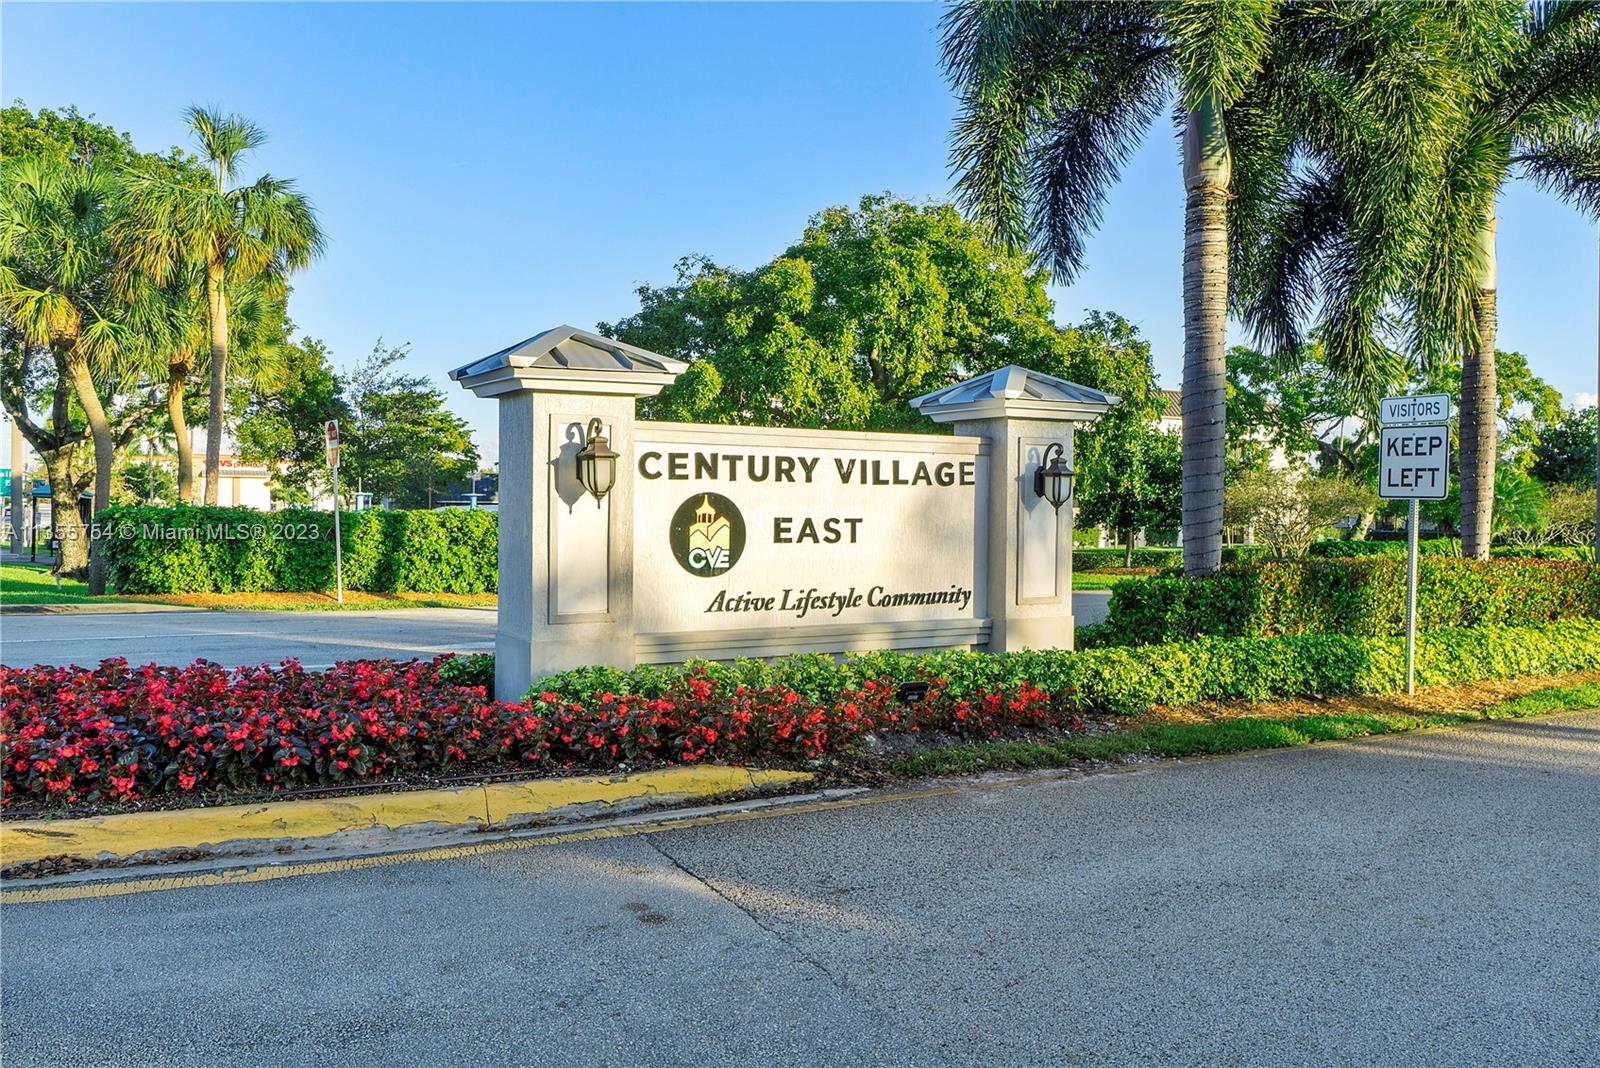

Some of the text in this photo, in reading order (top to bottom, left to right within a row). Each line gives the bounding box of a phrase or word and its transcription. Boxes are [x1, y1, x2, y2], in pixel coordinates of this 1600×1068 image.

[1389, 401, 1441, 418] VISITORS
[1387, 436, 1443, 457] KEEP
[637, 451, 976, 487] CENTURY VILLAGE
[1387, 468, 1440, 488] LEFT
[773, 517, 863, 544] EAST
[688, 546, 730, 569] CVE
[704, 584, 971, 619] Active Lifestyle Community
